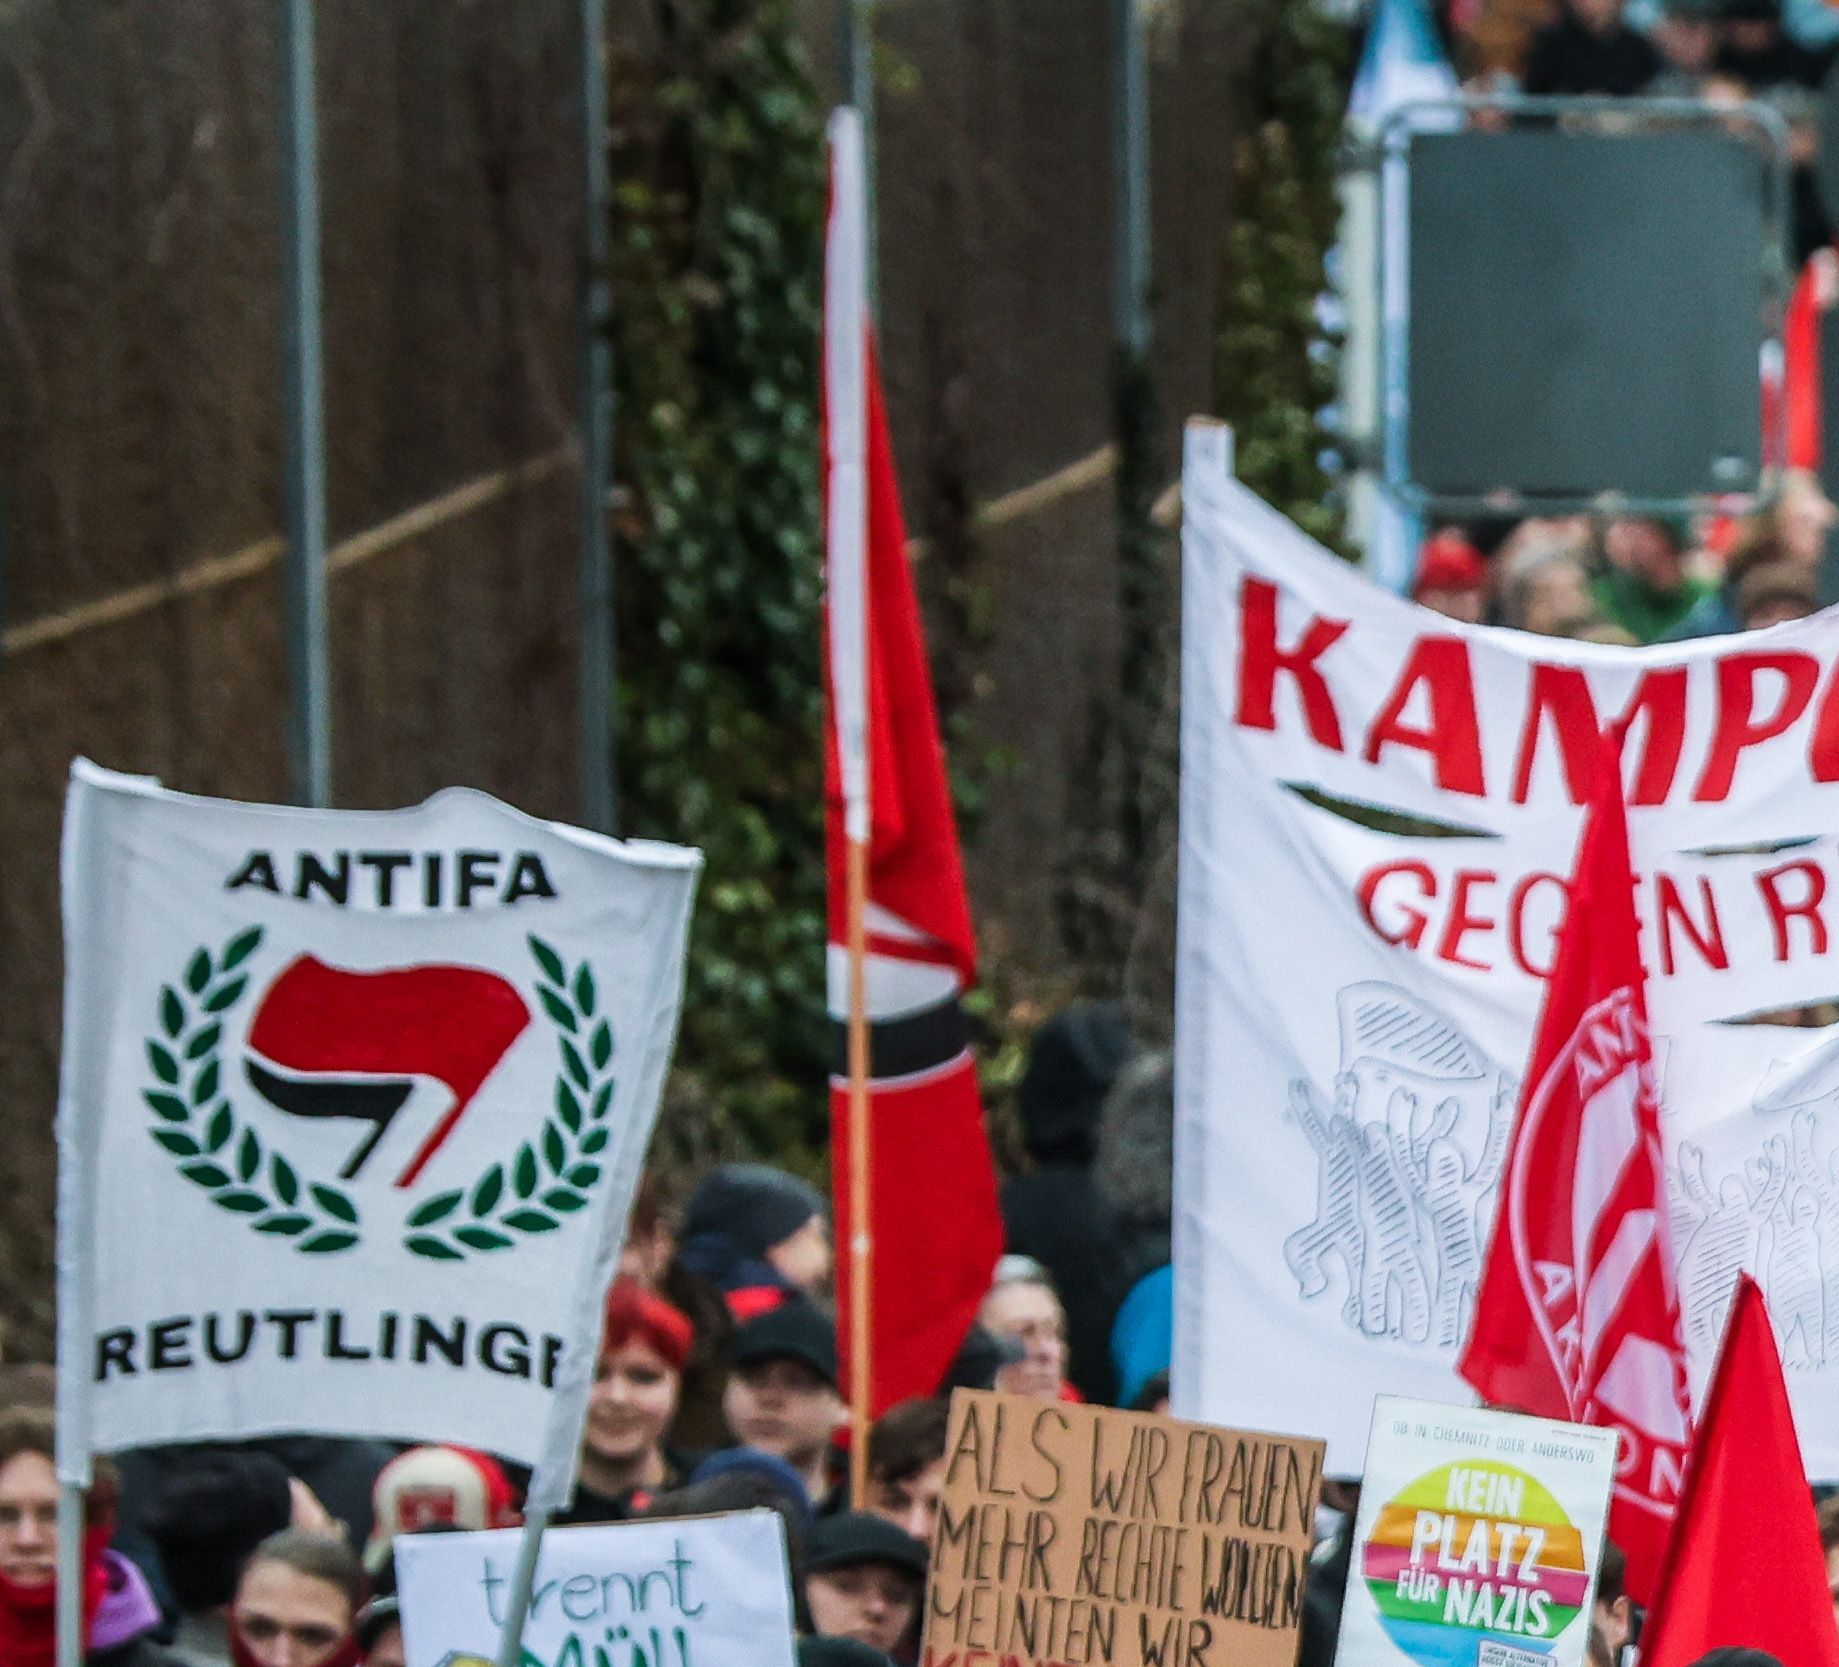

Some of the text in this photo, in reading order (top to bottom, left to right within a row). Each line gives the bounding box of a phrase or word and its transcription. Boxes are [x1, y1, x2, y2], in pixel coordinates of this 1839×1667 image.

[224, 849, 558, 907] ANTIFA
[946, 1400, 1320, 1536] ALS WIR FRAUEN
[1433, 1425, 1490, 1448] CHEMNITZ
[1532, 1440, 1595, 1465] ANDERSWO
[1444, 1466, 1526, 1518] KEIN
[481, 1539, 706, 1628] trennt
[933, 1501, 1056, 1592] MEHR
[1075, 1517, 1189, 1611] RECHTE
[1408, 1510, 1547, 1584] PLATZ
[928, 1583, 1118, 1665] MEINTEN
[1396, 1563, 1554, 1637] FÜR NAZIS
